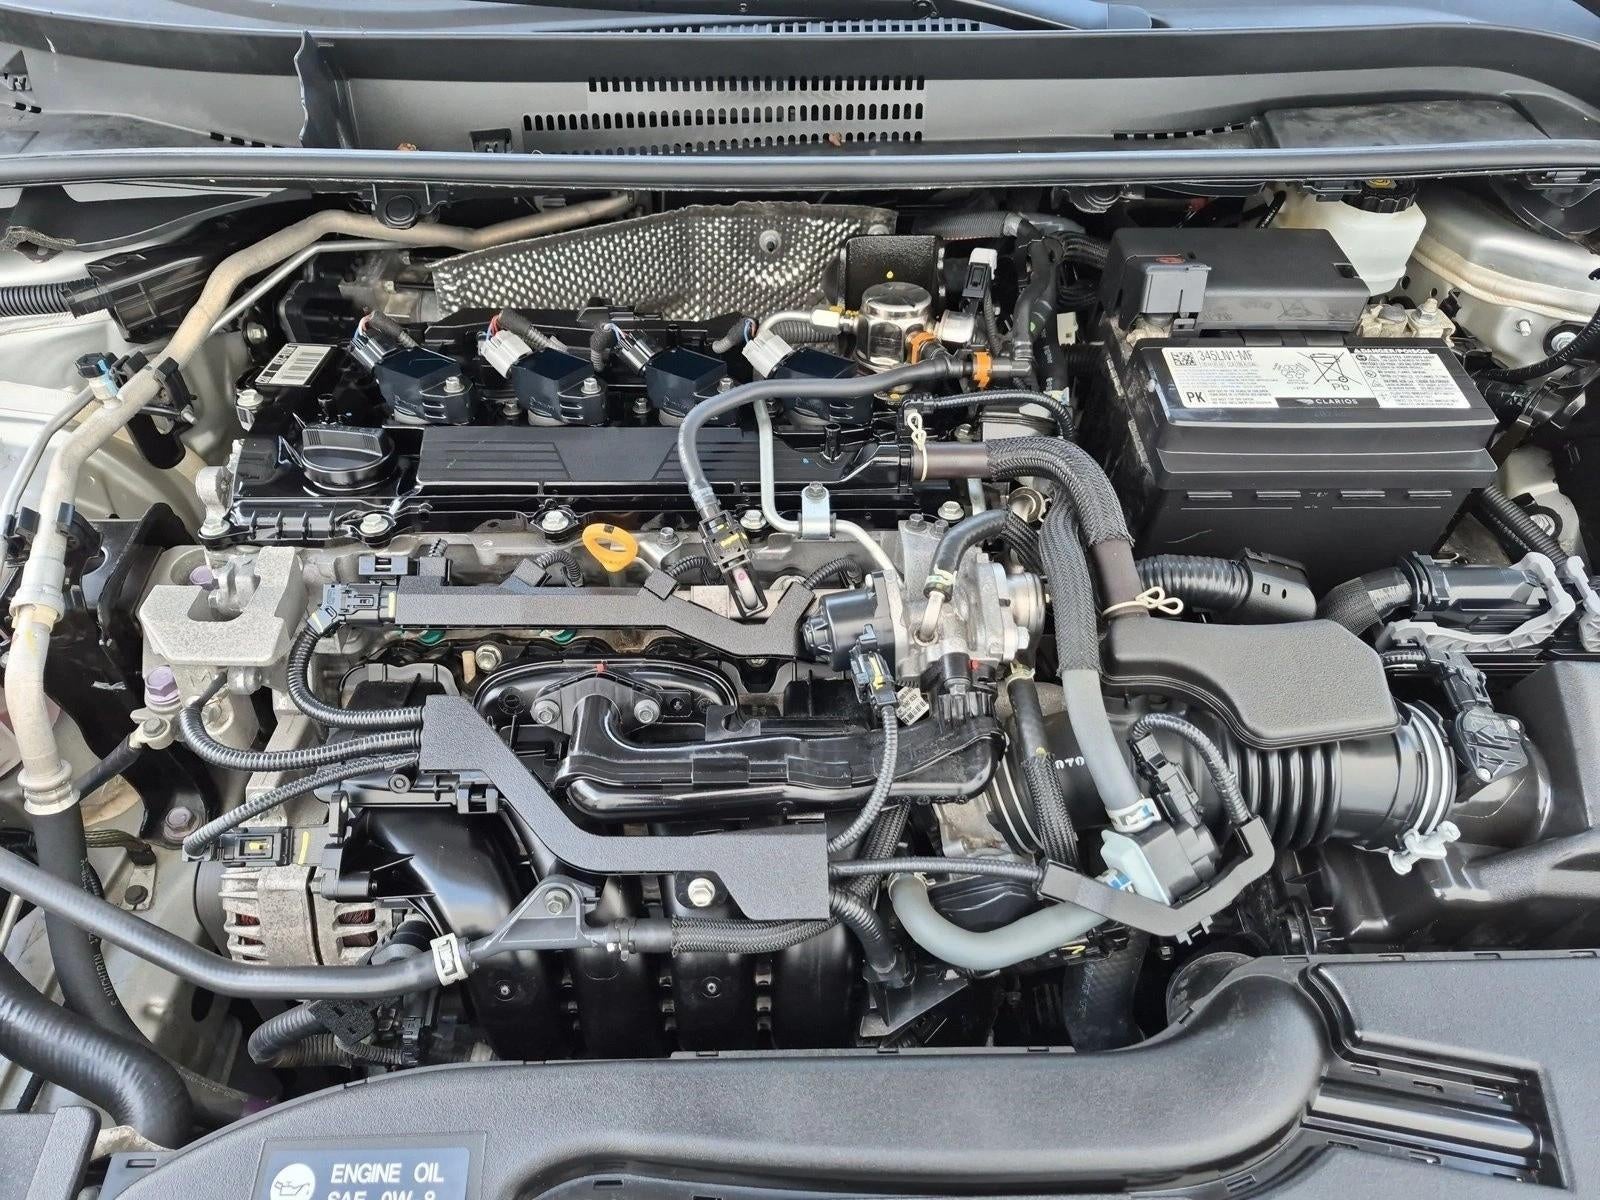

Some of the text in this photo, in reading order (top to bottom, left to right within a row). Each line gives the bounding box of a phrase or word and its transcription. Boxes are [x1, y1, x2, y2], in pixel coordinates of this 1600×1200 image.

[1186, 391, 1206, 403] PK
[330, 1161, 445, 1184] ENGINE OIL
